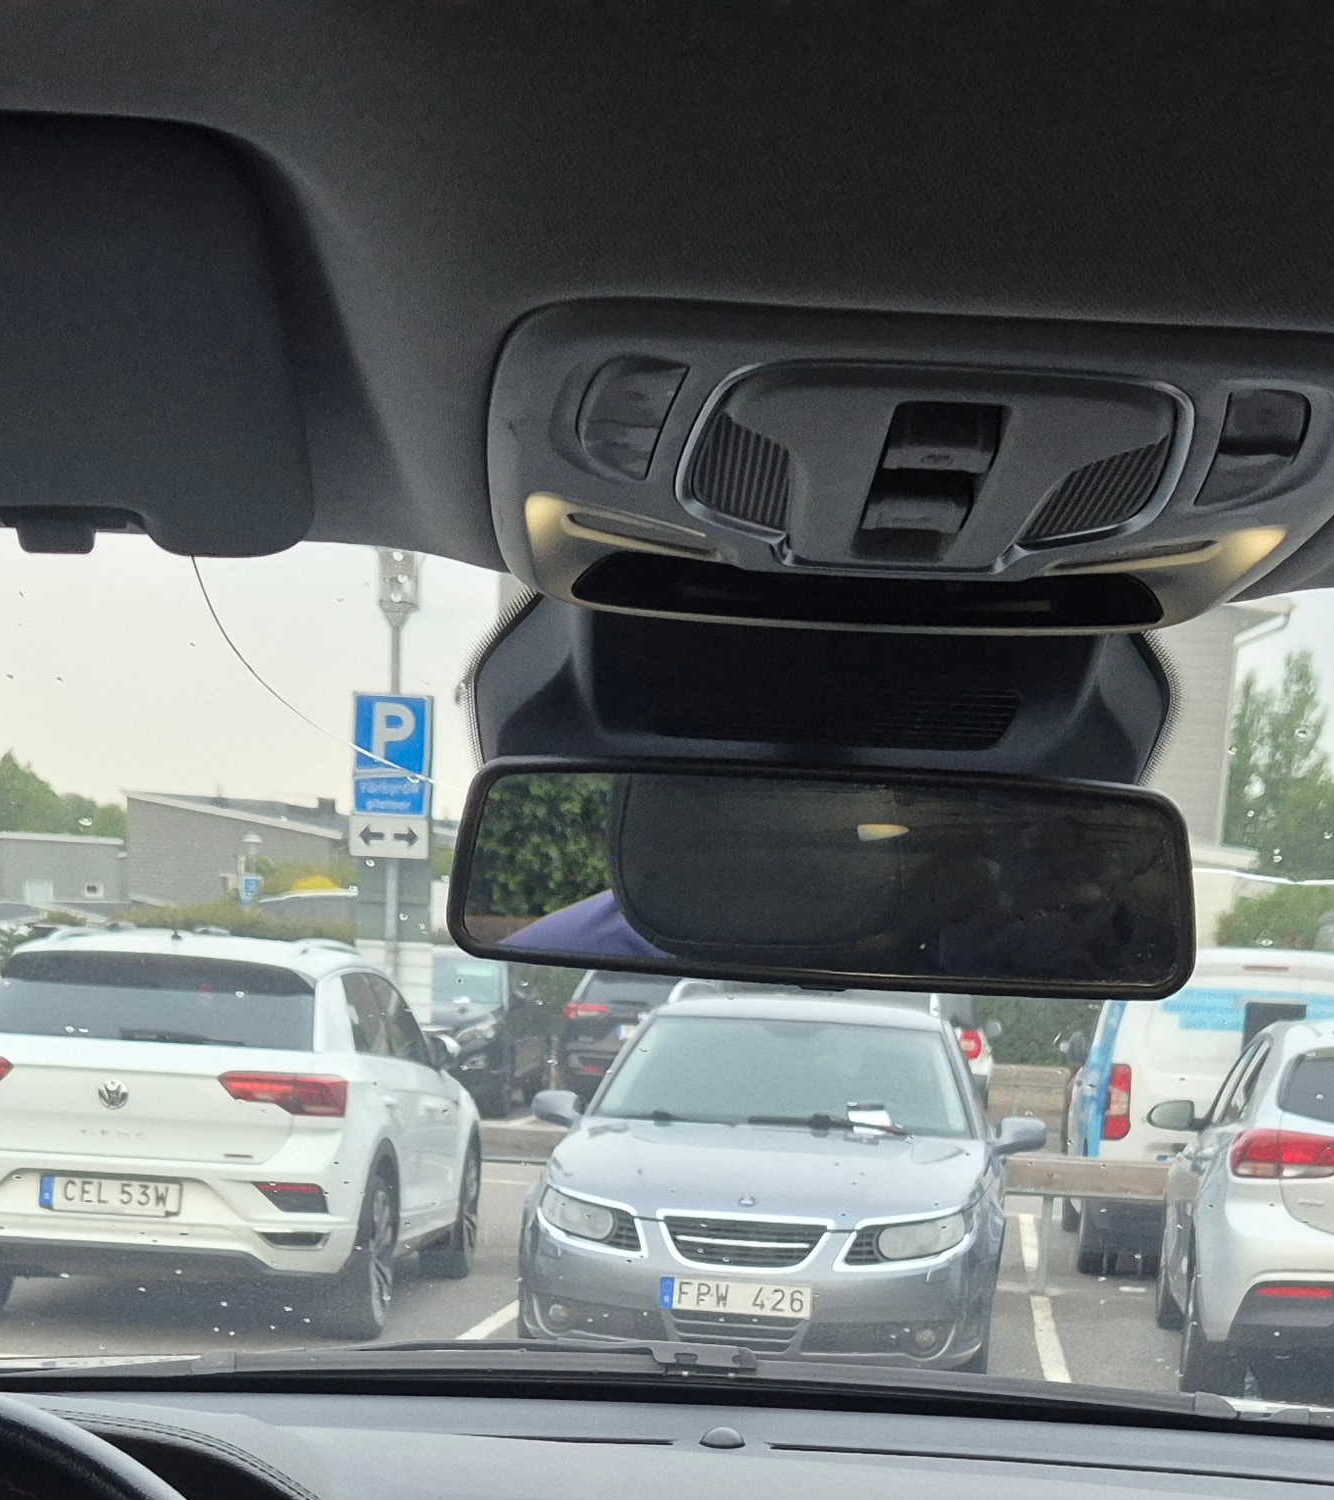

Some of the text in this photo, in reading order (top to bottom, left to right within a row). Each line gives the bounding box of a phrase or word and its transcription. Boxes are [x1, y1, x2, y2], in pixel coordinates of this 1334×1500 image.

[372, 702, 416, 763] P
[63, 1180, 170, 1208] CEL 53W
[677, 1281, 804, 1313] FPW 426
